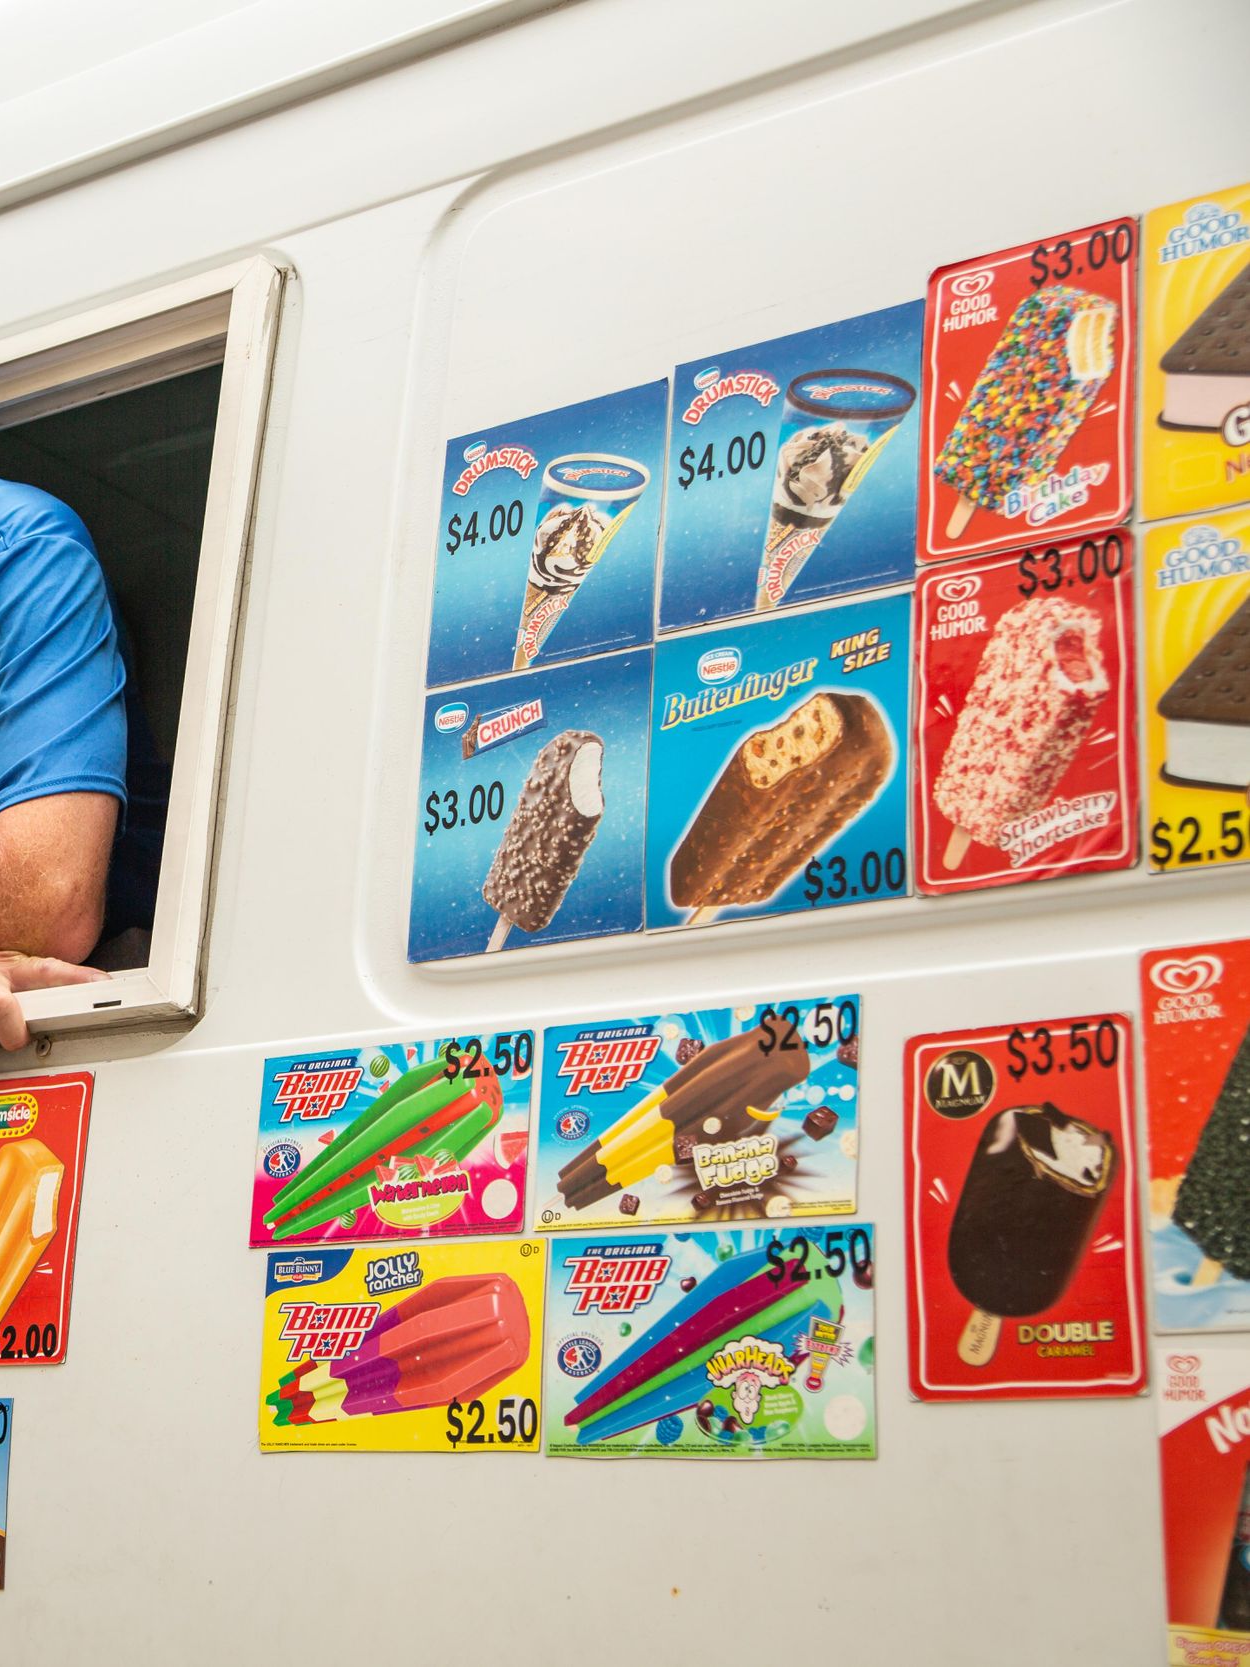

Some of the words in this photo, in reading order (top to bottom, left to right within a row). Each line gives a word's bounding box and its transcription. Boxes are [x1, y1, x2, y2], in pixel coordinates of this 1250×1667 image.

[1168, 213, 1240, 244] GOOD
[1029, 223, 1133, 289] $3.00
[942, 306, 998, 333] HUMOR
[950, 293, 991, 316] GOOD
[682, 373, 780, 424] DRUMSTICK
[453, 447, 538, 496] DRUMSTICK
[678, 431, 766, 490] $4.00
[1005, 463, 1111, 518] Birthday
[1027, 486, 1087, 526] Cake
[446, 500, 524, 556] $4.00
[766, 528, 820, 603] DRUMSTICK
[1018, 534, 1123, 600] $3.00
[1164, 538, 1241, 568] GOOD
[930, 615, 987, 640] HUMOR
[937, 601, 979, 622] GOOD
[523, 595, 569, 661] DRUMSTICK
[830, 627, 881, 659] KING
[841, 641, 891, 673] SIZE
[661, 657, 818, 730] Butterfinger
[478, 700, 541, 745] CRUNCH
[424, 780, 505, 836] $3.00
[999, 792, 1116, 848] Strawberry
[1010, 808, 1108, 868] Shortcake
[1150, 811, 1250, 872] $2.5
[803, 847, 906, 908] $3.00
[1153, 1004, 1223, 1025] HUMOR
[1157, 991, 1214, 1011] GOOD
[596, 1027, 649, 1040] ORIGINAL
[758, 1001, 858, 1057] $2.50
[293, 1063, 308, 1071] THE
[309, 1058, 352, 1070] ORIGINAL
[443, 1032, 532, 1085] $2.50
[557, 1036, 662, 1068] BOMB
[1007, 1020, 1119, 1082] $3.50
[274, 1067, 364, 1096] BOMB
[558, 1063, 644, 1096] POP
[940, 1061, 981, 1098] M
[274, 1093, 350, 1123] POP
[698, 1136, 775, 1168] Banana
[701, 1156, 776, 1188] Fudge
[587, 1248, 603, 1256] THE
[604, 1245, 658, 1256] ORIGINAL
[766, 1229, 871, 1289] $2.50
[278, 1265, 295, 1274] BLUE
[296, 1264, 318, 1273] BUNNY
[367, 1253, 417, 1282] JOLLY
[368, 1269, 421, 1293] rancher
[564, 1256, 672, 1287] BOMB
[564, 1283, 652, 1315] POP
[280, 1302, 381, 1331] BOMB
[1017, 1320, 1114, 1345] DOUBLE
[280, 1330, 365, 1361] POP
[1037, 1345, 1095, 1358] CARAMEL
[706, 1345, 796, 1386] WARHEADS
[446, 1397, 538, 1449] $2.50
